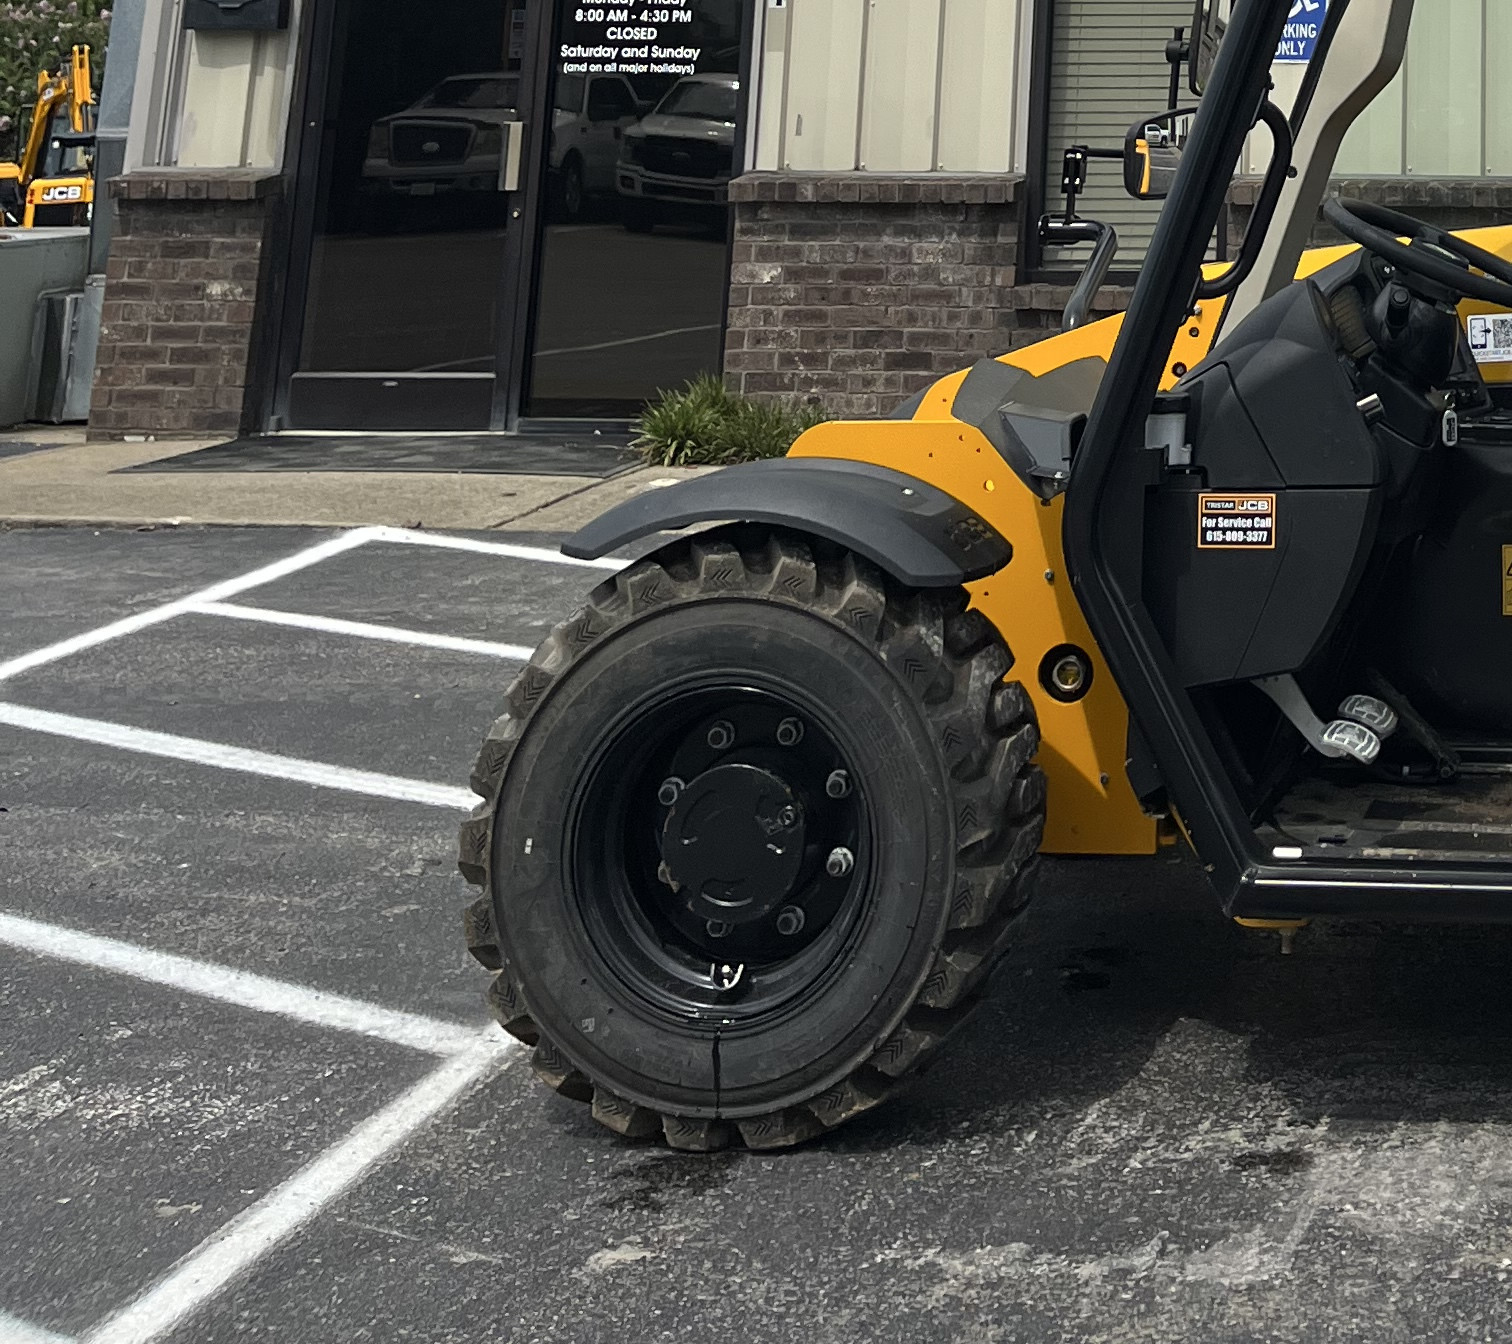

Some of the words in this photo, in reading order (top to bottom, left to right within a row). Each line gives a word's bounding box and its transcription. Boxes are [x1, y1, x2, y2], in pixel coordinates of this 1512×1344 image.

[574, 9, 604, 22] 8:00
[606, 9, 628, 22] AM
[639, 9, 669, 23] 4:30
[671, 10, 692, 23] PM
[606, 26, 658, 40] CLOSED
[1282, 23, 1317, 39] RKING
[560, 44, 619, 60] Saturday
[621, 45, 649, 58] and
[651, 45, 701, 61] Sunday
[563, 62, 588, 74] (and
[588, 63, 603, 72] on
[605, 62, 618, 72] all
[618, 63, 649, 74] major
[650, 63, 696, 75] holidays)
[42, 186, 81, 200] JCB
[1206, 501, 1235, 509] TRISTAR
[1238, 500, 1269, 511] JCB
[1202, 516, 1217, 528] For
[1217, 516, 1253, 528] Service
[1253, 516, 1273, 528] Call
